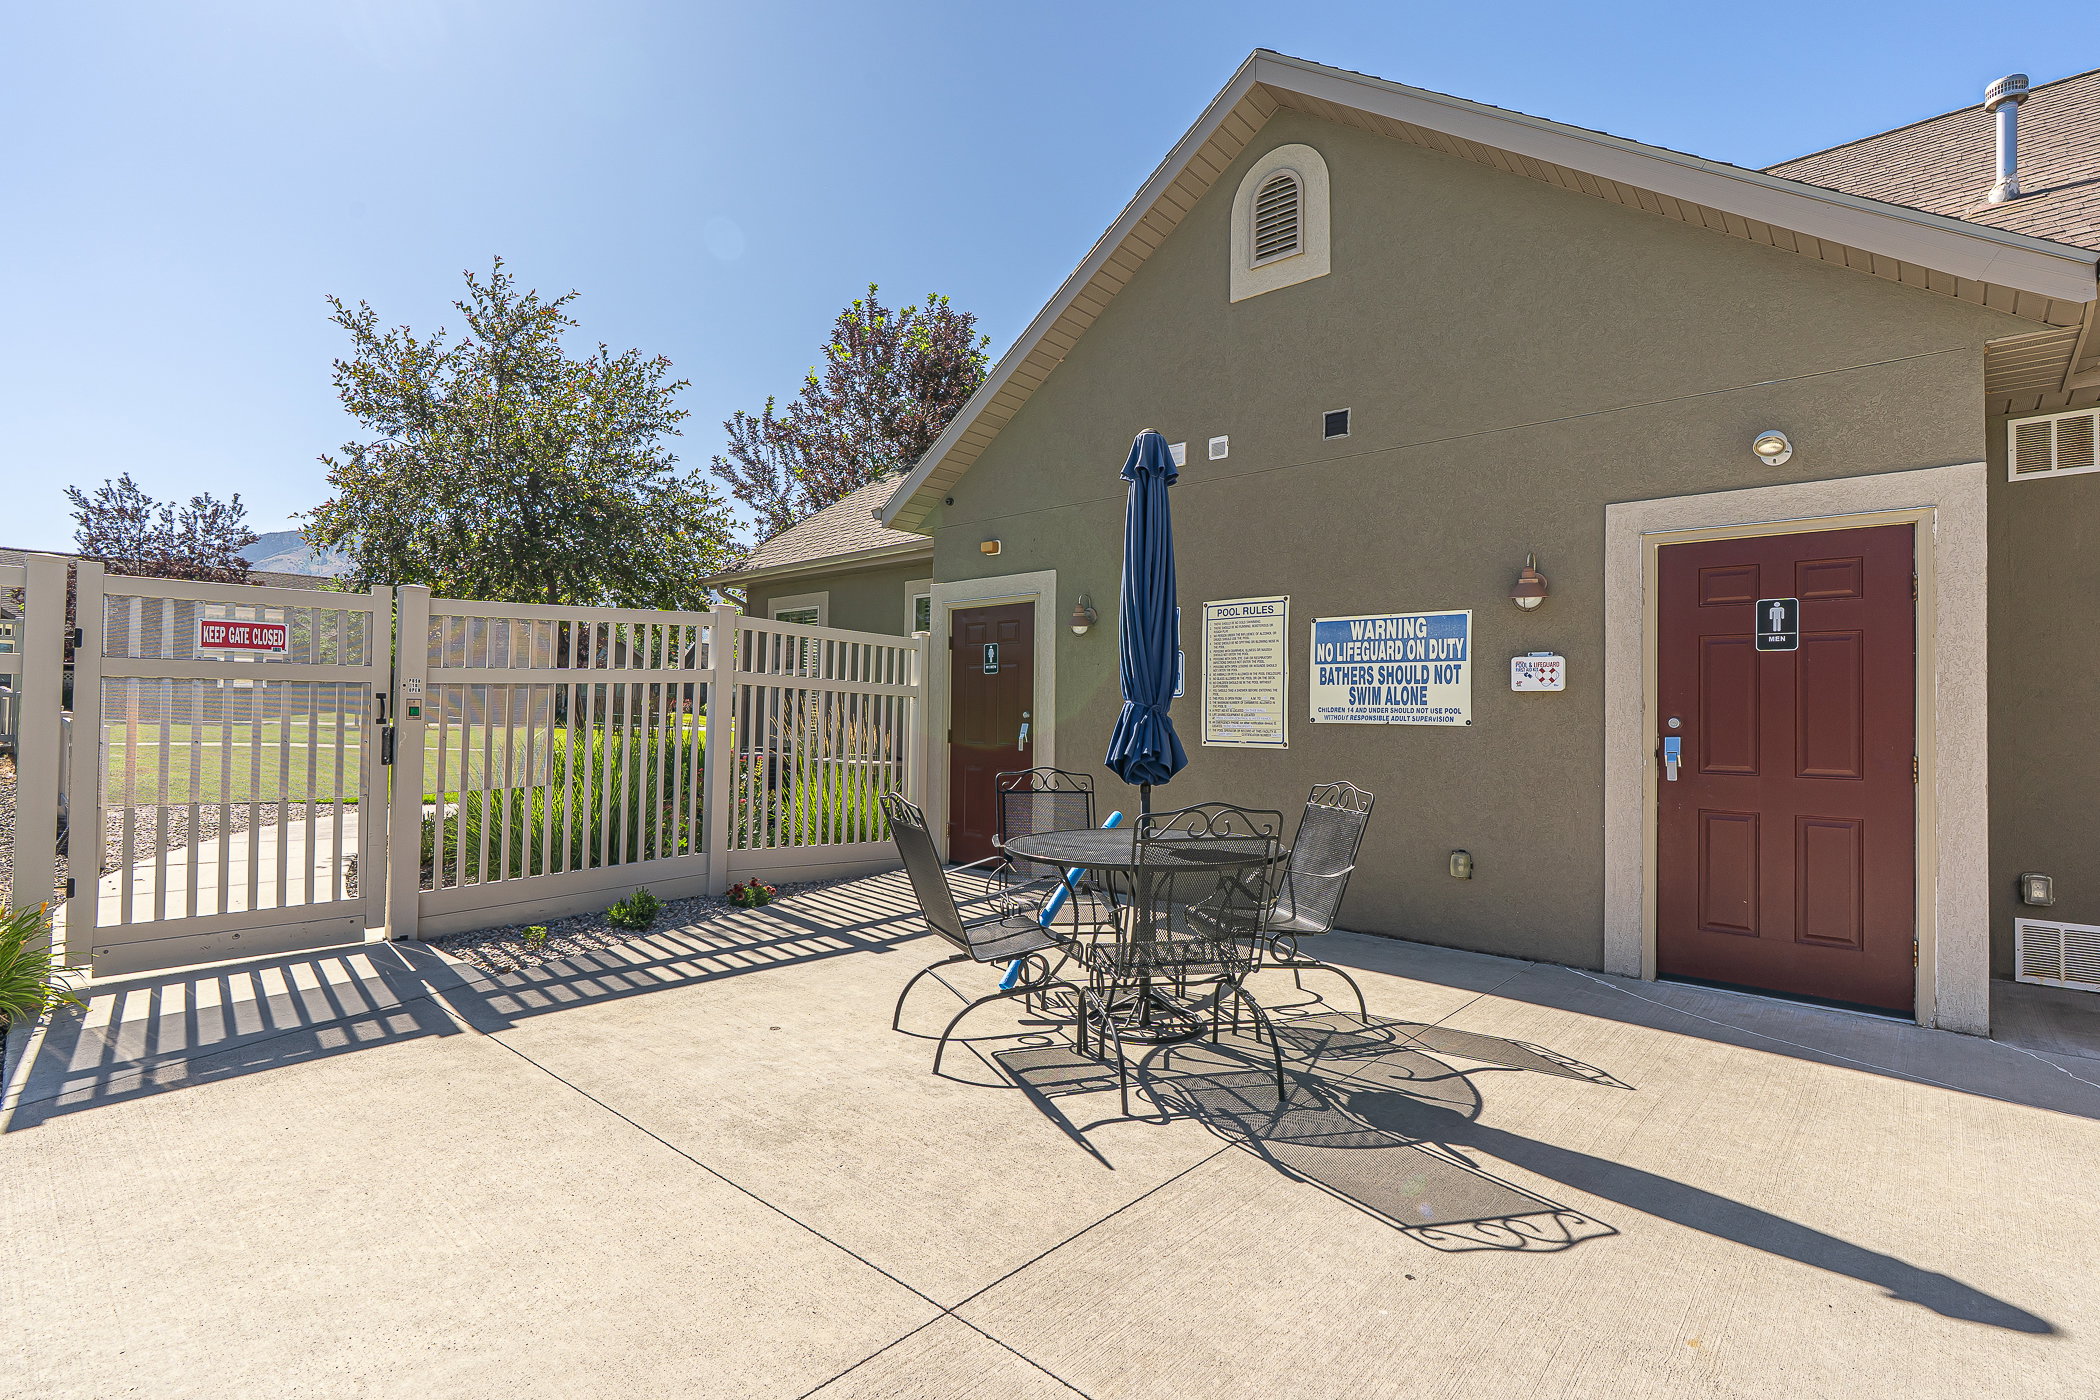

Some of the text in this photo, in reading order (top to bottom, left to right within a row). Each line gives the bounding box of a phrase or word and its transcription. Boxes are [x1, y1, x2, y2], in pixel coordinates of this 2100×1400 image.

[1217, 605, 1274, 616] POOL RULES
[204, 626, 284, 645] KEEP GATE CLOSED
[1350, 618, 1427, 640] WARNING
[1317, 638, 1464, 662] NO LIFEGUARD ON DUTY
[1320, 664, 1461, 685] BATHERS SHOULD NOT
[1349, 686, 1427, 705] SWIM ALONE
